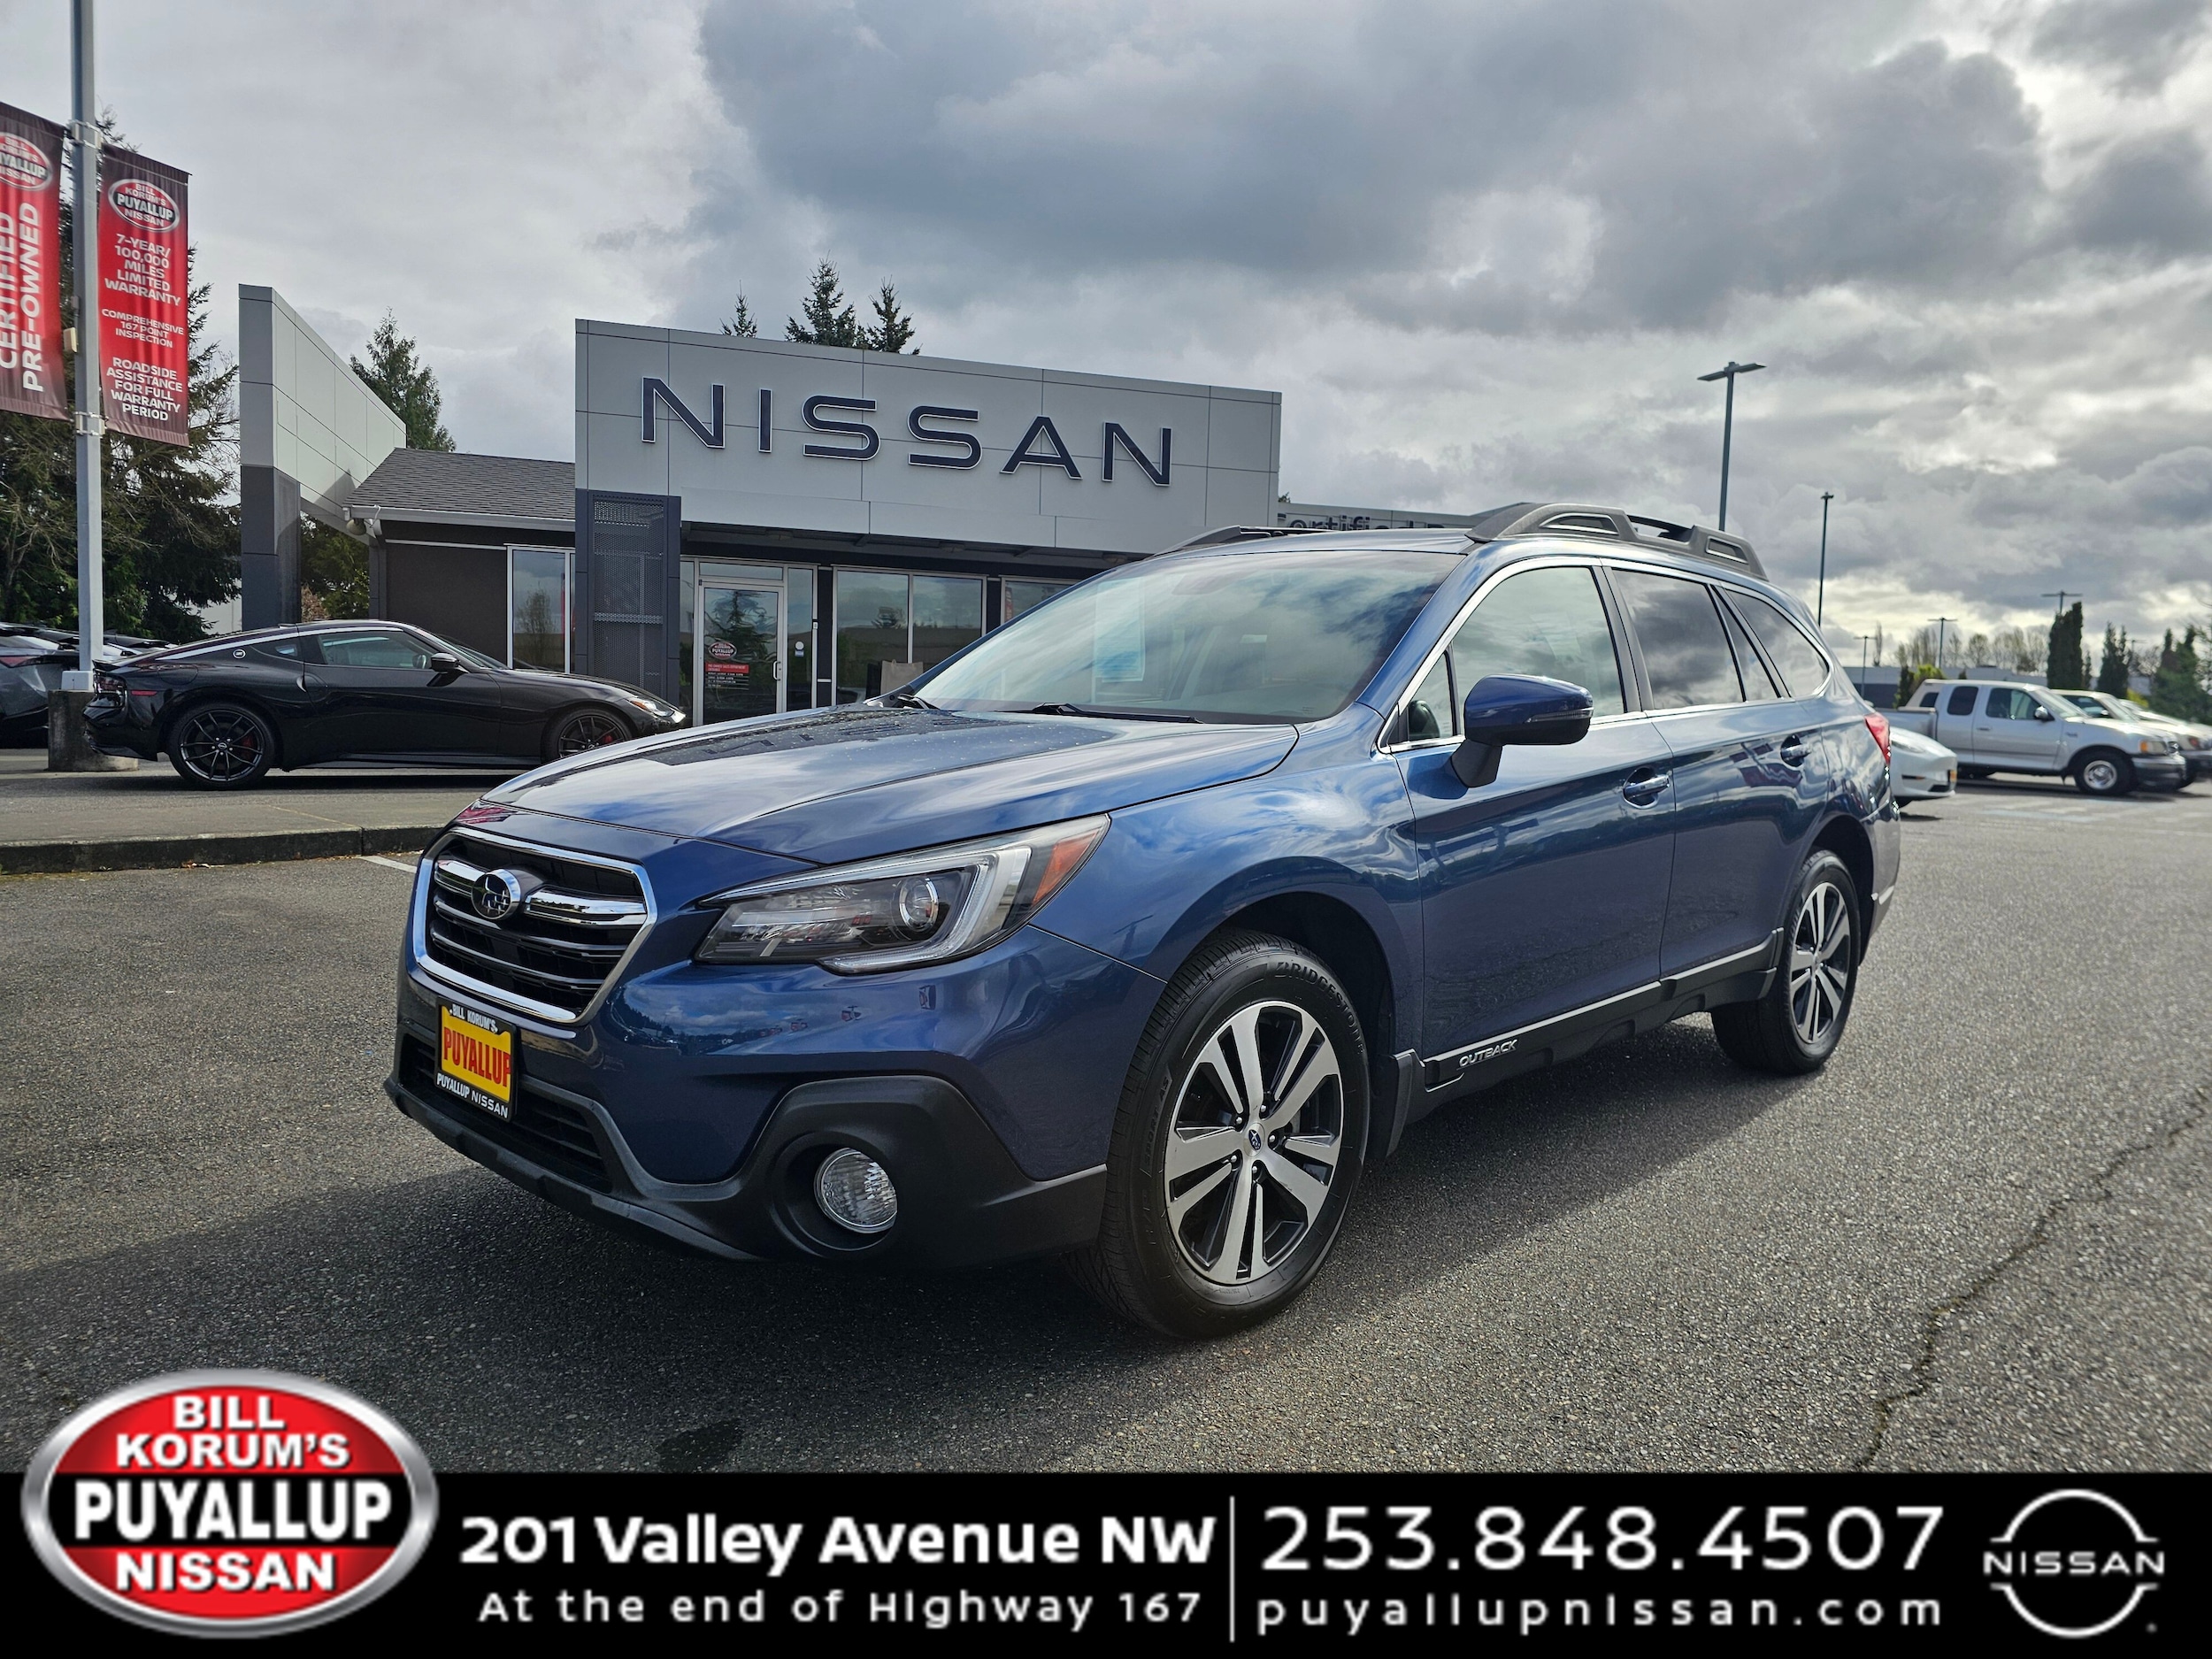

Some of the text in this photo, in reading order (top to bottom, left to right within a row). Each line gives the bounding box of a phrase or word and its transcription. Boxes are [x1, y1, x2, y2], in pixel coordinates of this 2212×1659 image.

[125, 187, 166, 206] KORUM'S
[135, 183, 156, 196] BILL
[117, 193, 174, 220] PUYALLUP
[124, 209, 165, 227] NISSAN
[114, 245, 170, 269] 100,000
[116, 233, 171, 258] 7-YEAR/
[117, 269, 171, 292] LIMITED
[124, 259, 165, 279] MILES
[19, 202, 43, 392] PRE-OWNED
[104, 278, 180, 306] WARRANTY
[102, 309, 184, 335] COMPREHENSIVE
[120, 320, 170, 339] 167 POINT
[115, 327, 173, 348] INSPECTION
[106, 367, 183, 392] ASSISTANCE
[112, 357, 177, 380] ROADSIDE
[111, 389, 181, 413] WARRANTY
[114, 379, 174, 401] FOR FULL
[122, 403, 168, 421] PERIOD
[641, 376, 1172, 488] NISSAN
[452, 1003, 496, 1033] BILL KORUM'S
[443, 1026, 511, 1087] PUYALLUP
[1459, 1039, 1518, 1067] OUTBACK
[437, 1072, 509, 1118] PUYALLUP NISSAN
